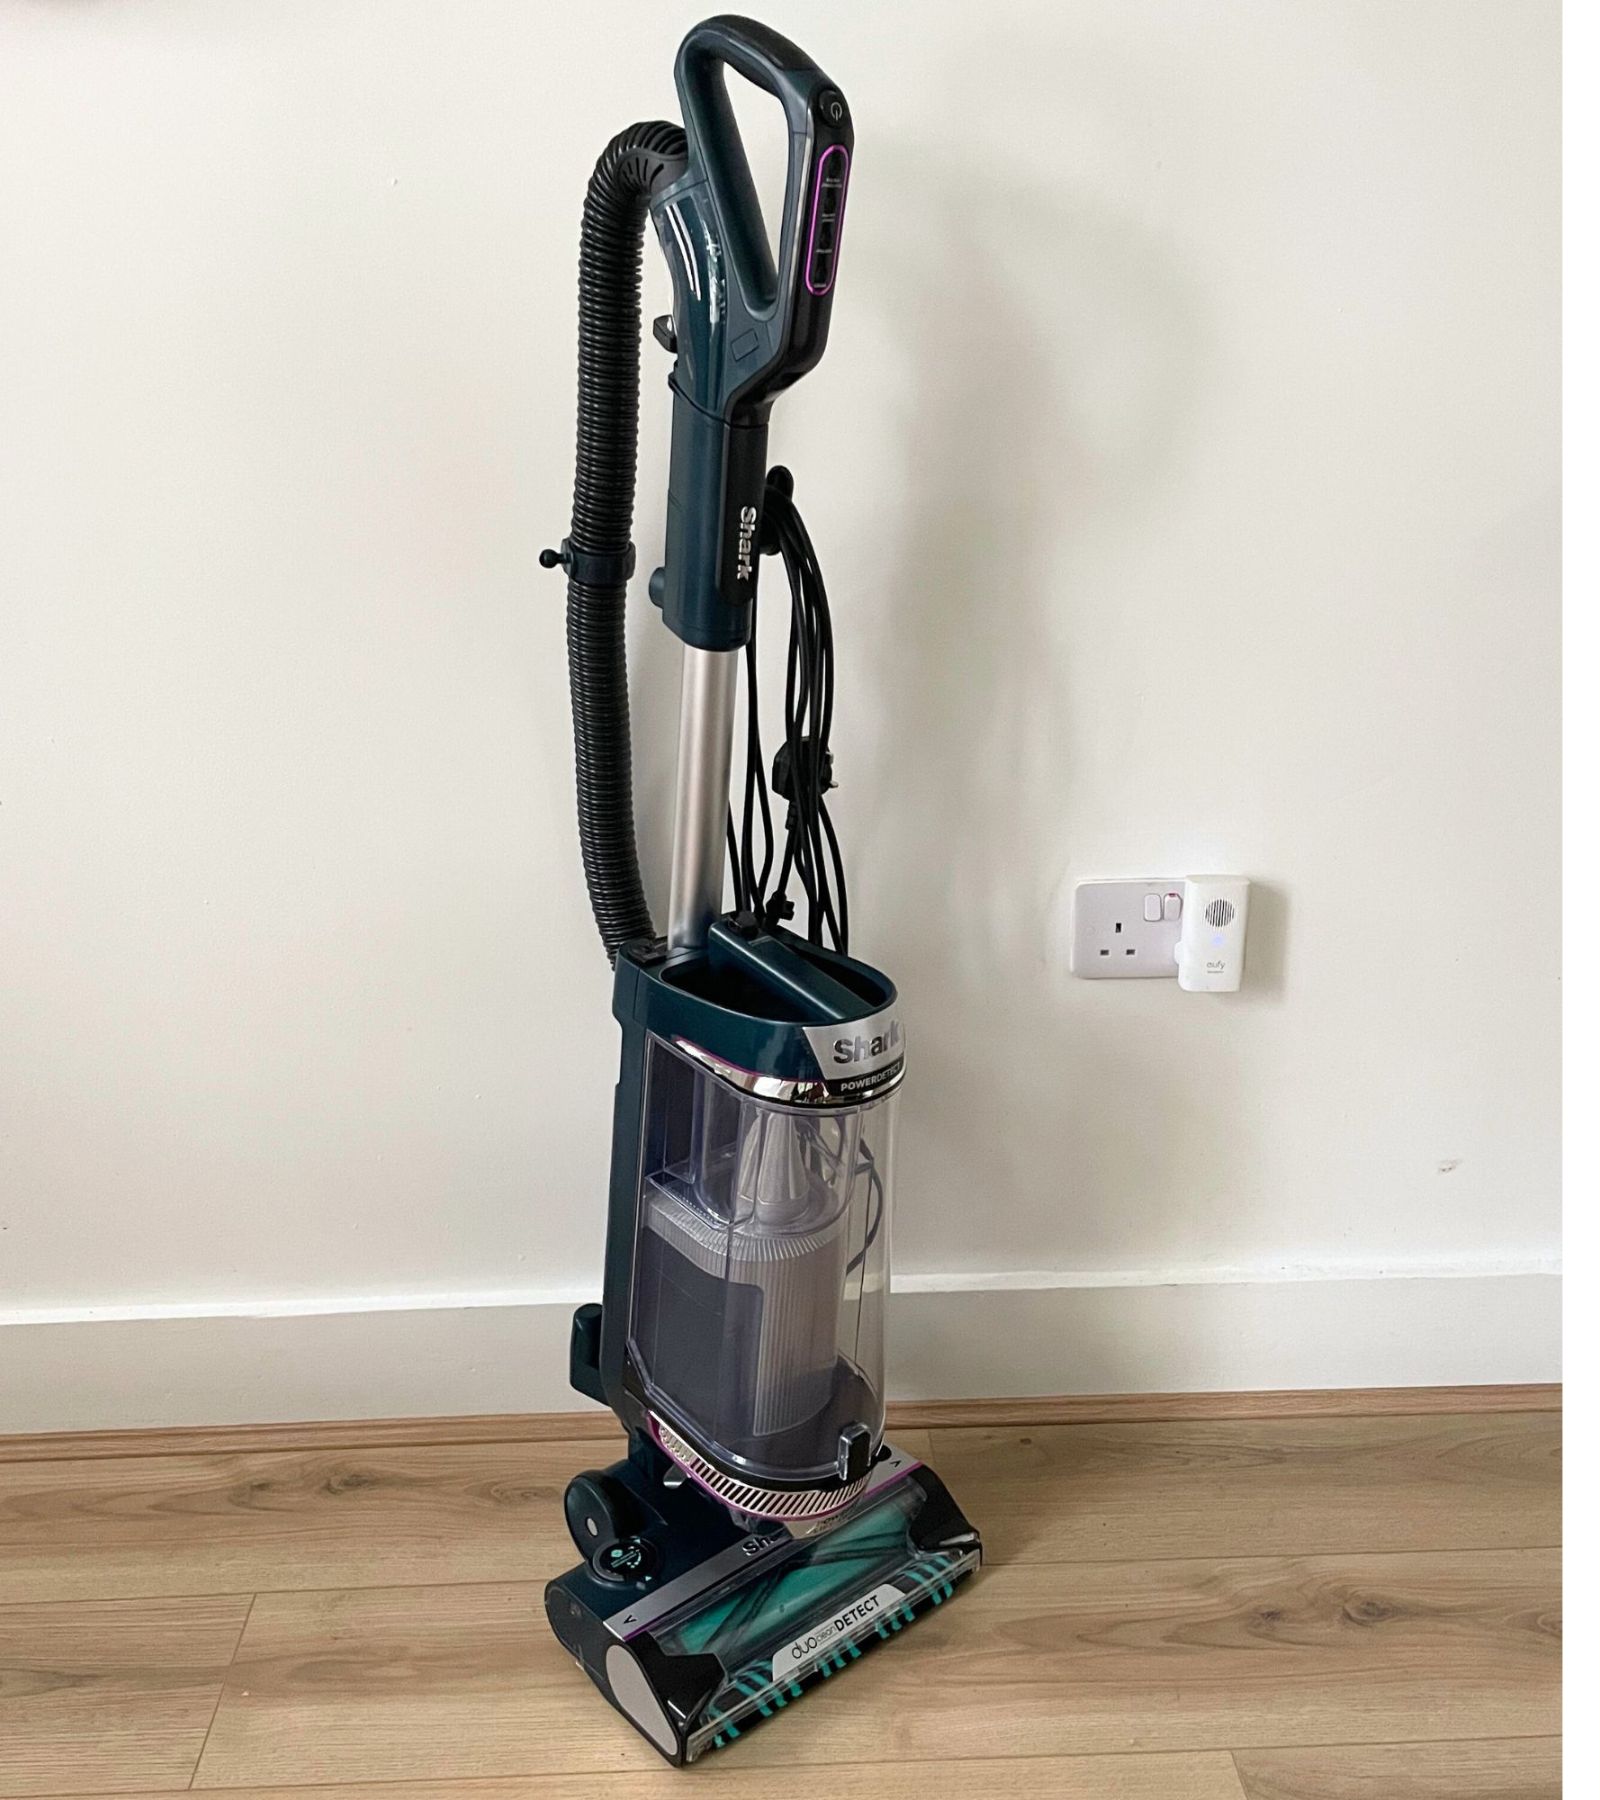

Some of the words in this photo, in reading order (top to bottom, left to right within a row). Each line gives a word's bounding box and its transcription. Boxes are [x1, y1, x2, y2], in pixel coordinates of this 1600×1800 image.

[736, 506, 757, 581] Shark
[833, 1020, 900, 1064] Shark
[833, 1595, 880, 1632] DETECT
